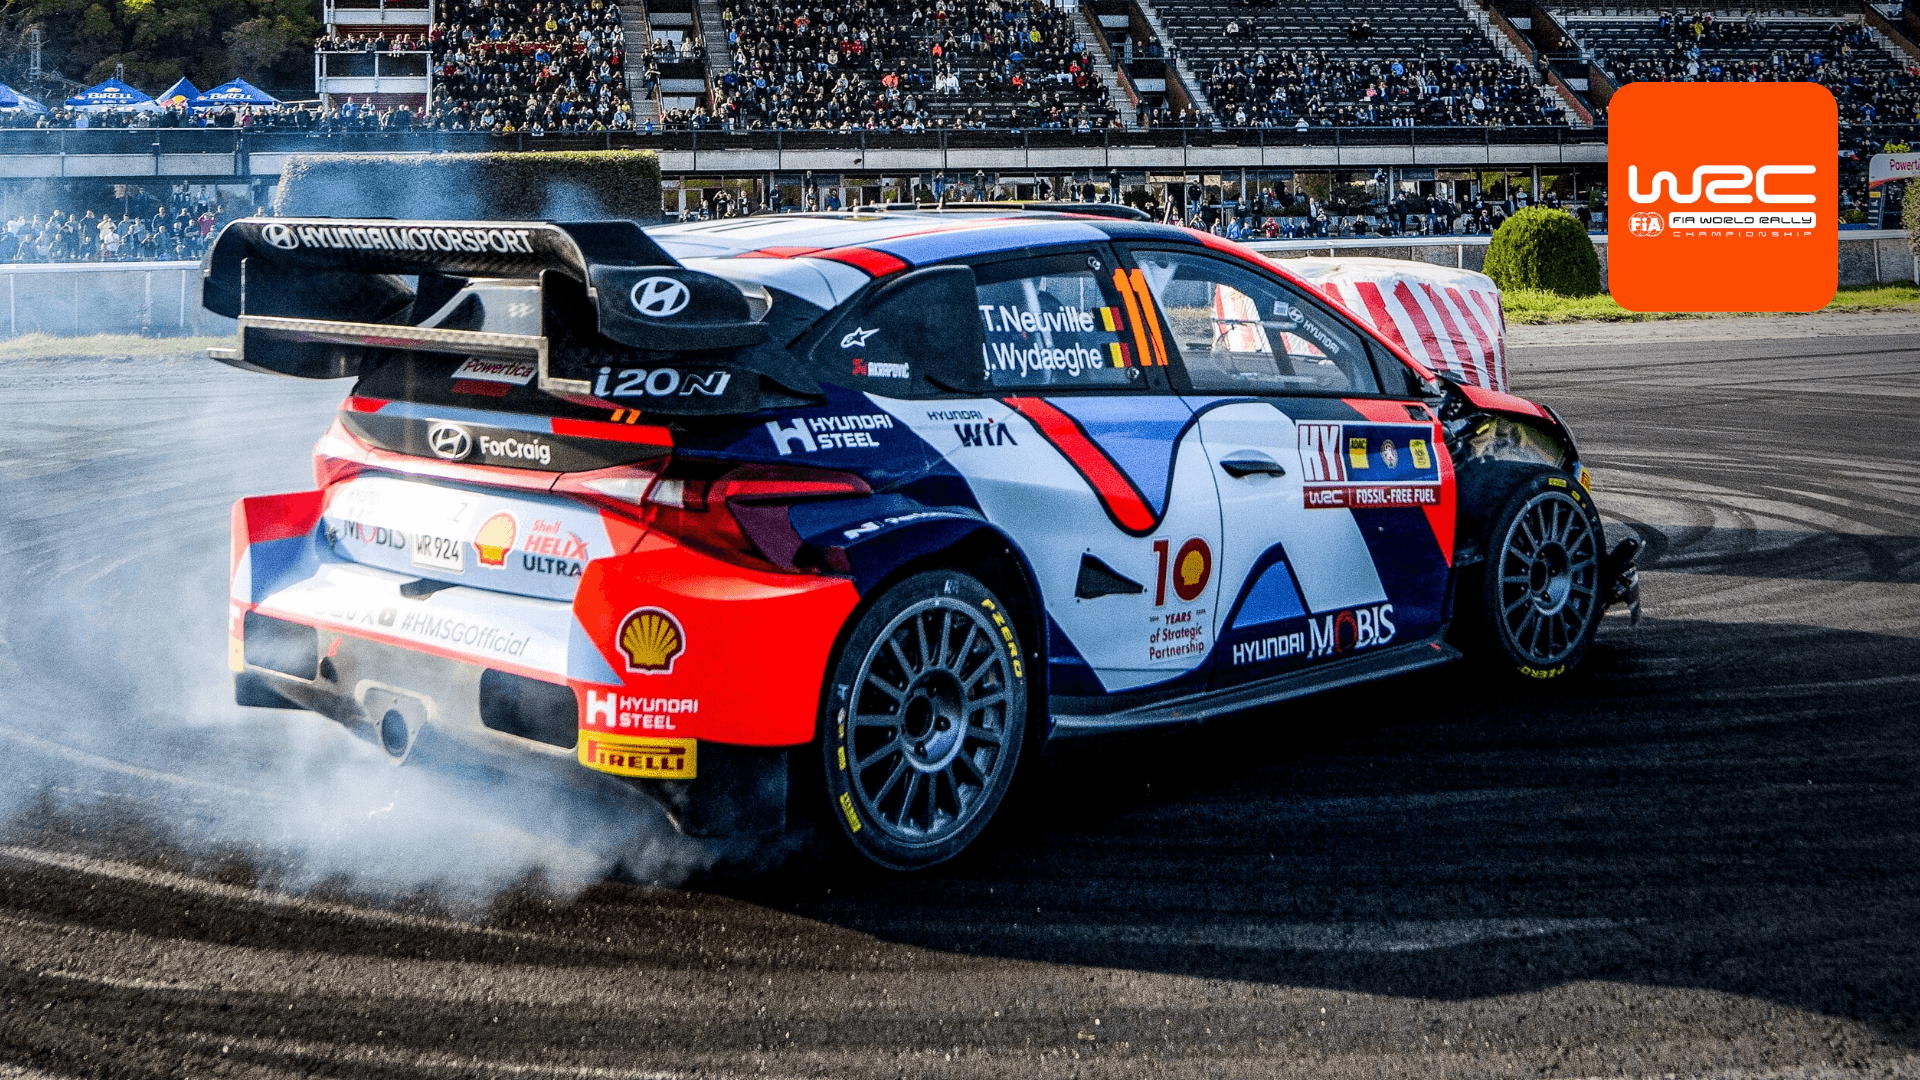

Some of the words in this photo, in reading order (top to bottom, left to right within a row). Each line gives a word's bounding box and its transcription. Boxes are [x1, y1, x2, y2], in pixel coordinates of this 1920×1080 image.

[299, 226, 395, 249] HYUNDAI
[395, 228, 535, 253] MOTORSPORT
[978, 304, 1095, 332] T.Neuville
[1113, 267, 1169, 366] 11
[1302, 318, 1340, 354] HYUNDAI
[462, 359, 535, 378] Powertica
[808, 414, 893, 433] HYUNDAI
[927, 410, 983, 421] HYUNDAI
[479, 435, 551, 465] ForCraig
[816, 431, 880, 449] STEEL
[1309, 490, 1343, 504] WRC
[1356, 488, 1412, 504] FOSSIL-FREE
[1414, 489, 1436, 503] FUEL
[532, 518, 562, 534] Shell
[434, 536, 460, 563] 924
[524, 533, 589, 559] HELIX
[523, 554, 583, 577] ULTRA
[1165, 611, 1192, 625] YEARS
[400, 611, 531, 656] #HMSGOfficial
[1150, 627, 1161, 643] of
[1162, 622, 1203, 642] Strategic
[1306, 604, 1397, 659] MOBIS
[1149, 640, 1205, 661] Partnership
[1233, 632, 1305, 665] HYUNDAI
[619, 695, 699, 713] HYUNDAI
[619, 712, 676, 730] STEEL
[587, 740, 686, 771] PIRELLI
